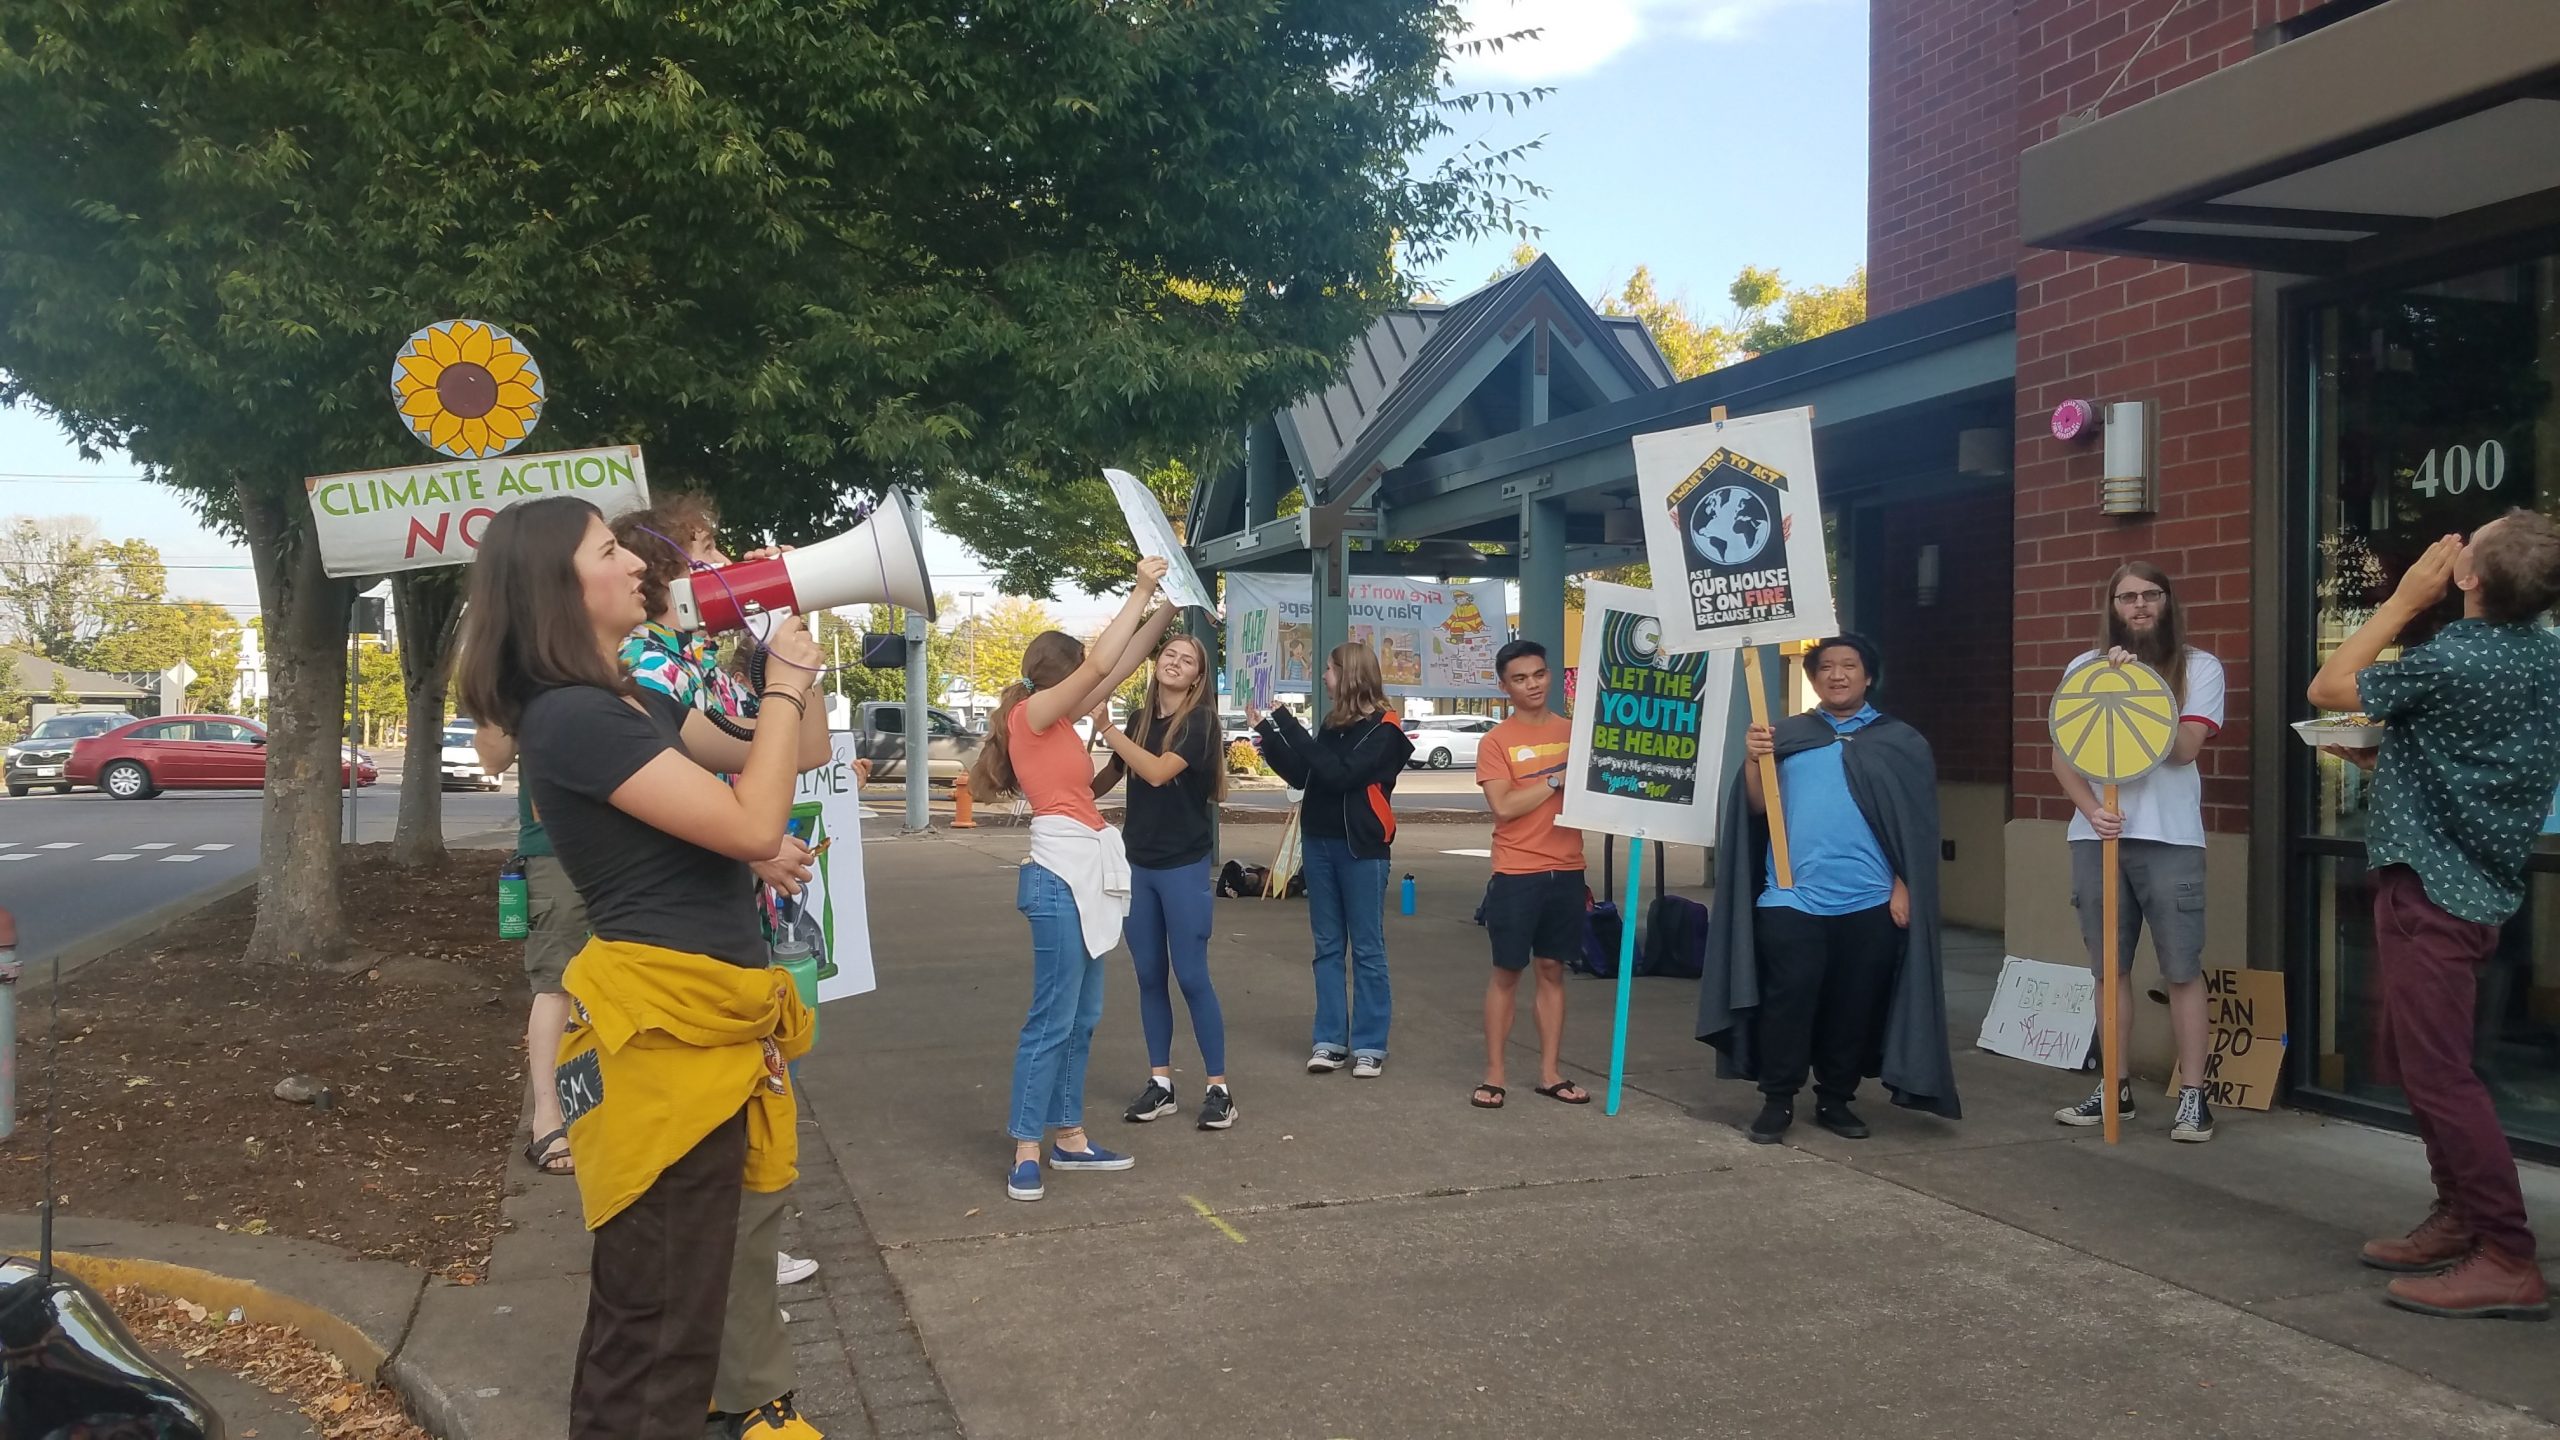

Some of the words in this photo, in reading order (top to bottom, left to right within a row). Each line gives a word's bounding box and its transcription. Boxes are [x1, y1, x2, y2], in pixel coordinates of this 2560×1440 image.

[1675, 469, 1705, 498] WANT
[1702, 450, 1724, 471] YOU
[1729, 453, 1749, 469] TO
[1751, 465, 1780, 483] ACT
[2412, 439, 2505, 498] 400
[319, 468, 484, 517] CLIMATE
[497, 454, 636, 497] ACTION
[404, 507, 498, 560] NO
[1690, 570, 1703, 581] AS
[1704, 569, 1712, 578] IF
[1691, 577, 1728, 597] OUR
[1729, 568, 1789, 592] HOUSE
[1695, 597, 1713, 614] IS
[1716, 592, 1743, 611] ON
[1697, 608, 1751, 626] BECAUSE
[1753, 605, 1768, 618] IT
[1610, 666, 1649, 691] LET
[1653, 670, 1692, 698] THE
[1601, 690, 1697, 733] YOUTH
[1593, 725, 1620, 751] BE
[1624, 729, 1696, 759] HEARD
[800, 763, 849, 796] IME
[2202, 969, 2237, 995] WE
[2019, 1013, 2039, 1032] NOT
[2213, 1027, 2253, 1057] DO
